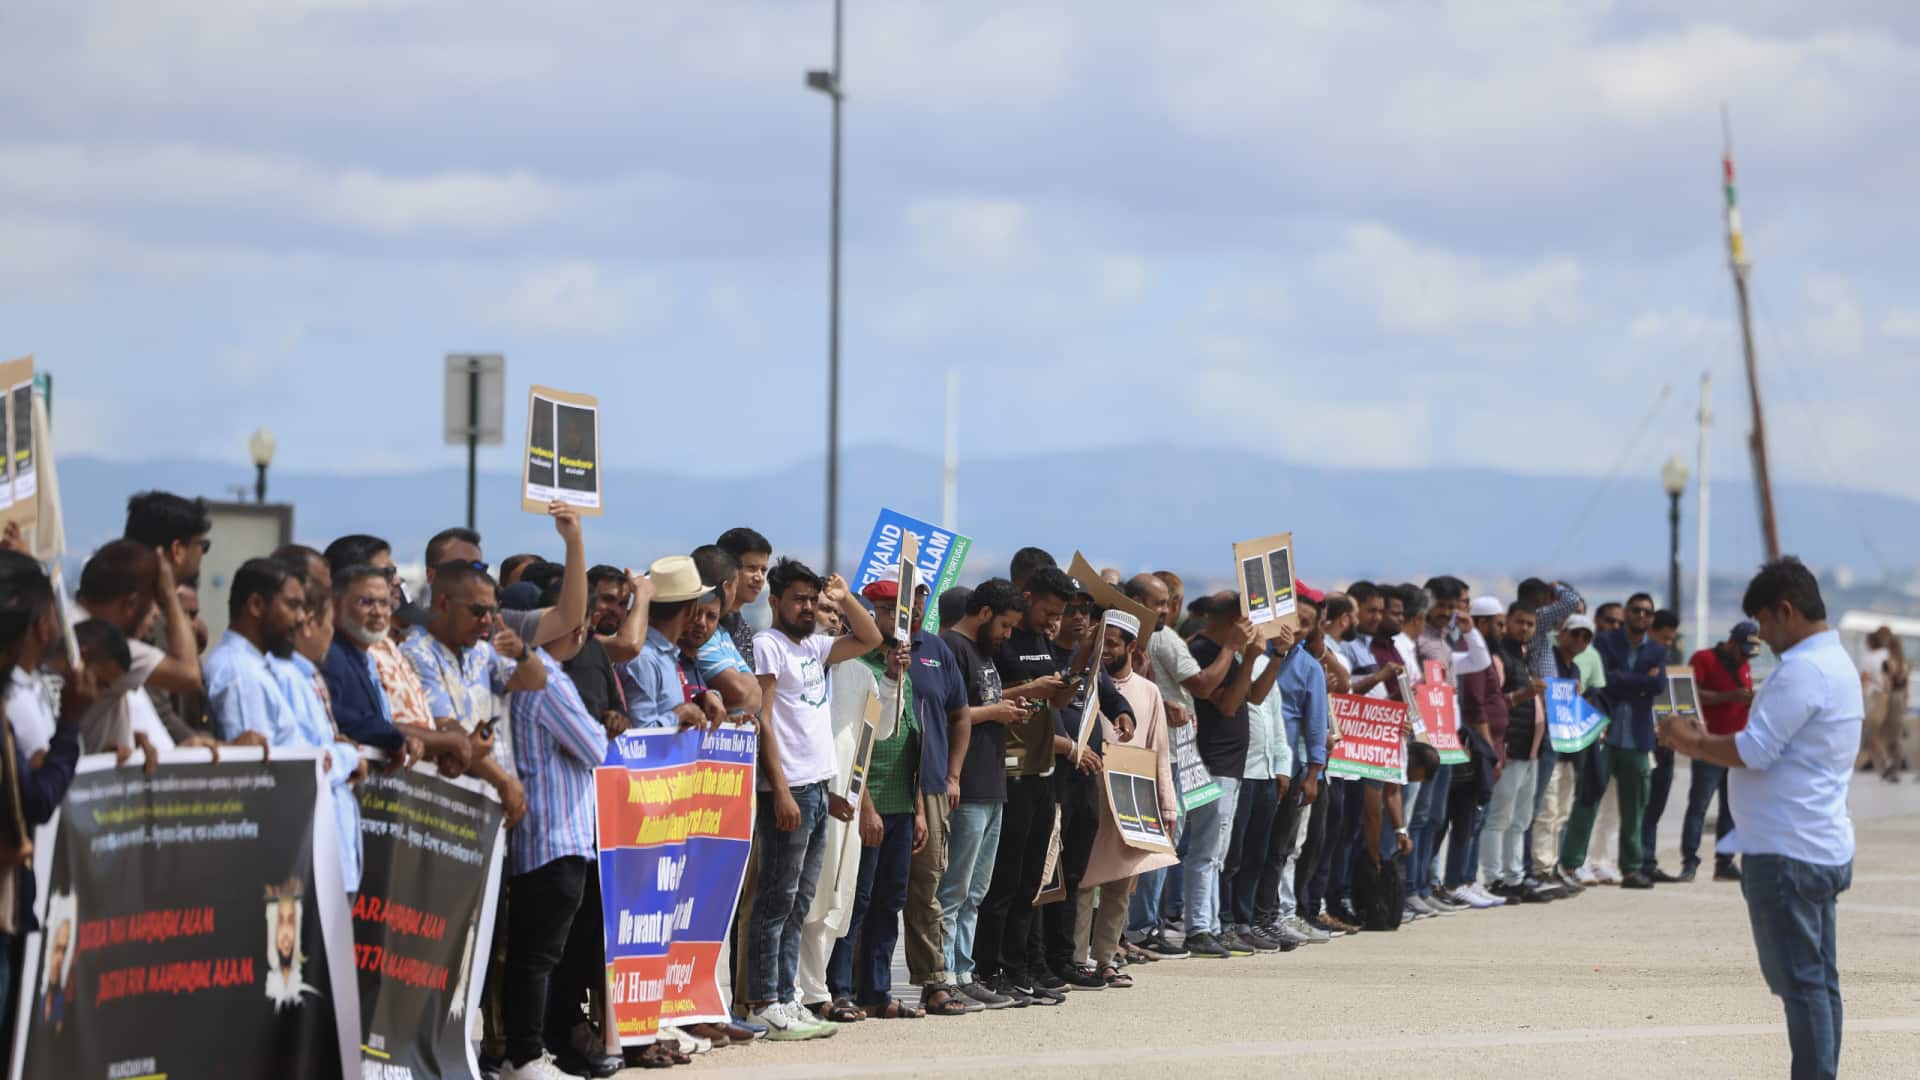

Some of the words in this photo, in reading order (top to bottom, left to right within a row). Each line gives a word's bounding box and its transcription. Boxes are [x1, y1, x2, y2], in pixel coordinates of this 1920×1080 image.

[946, 540, 966, 576] PORTUGAL
[1335, 698, 1360, 718] TEJA
[1362, 704, 1403, 724] NOSSAS
[1338, 718, 1399, 743] UNIDADES
[1344, 741, 1400, 768] INJUSTIÇA
[657, 856, 677, 891] We
[618, 909, 633, 945] We
[633, 909, 662, 943] want
